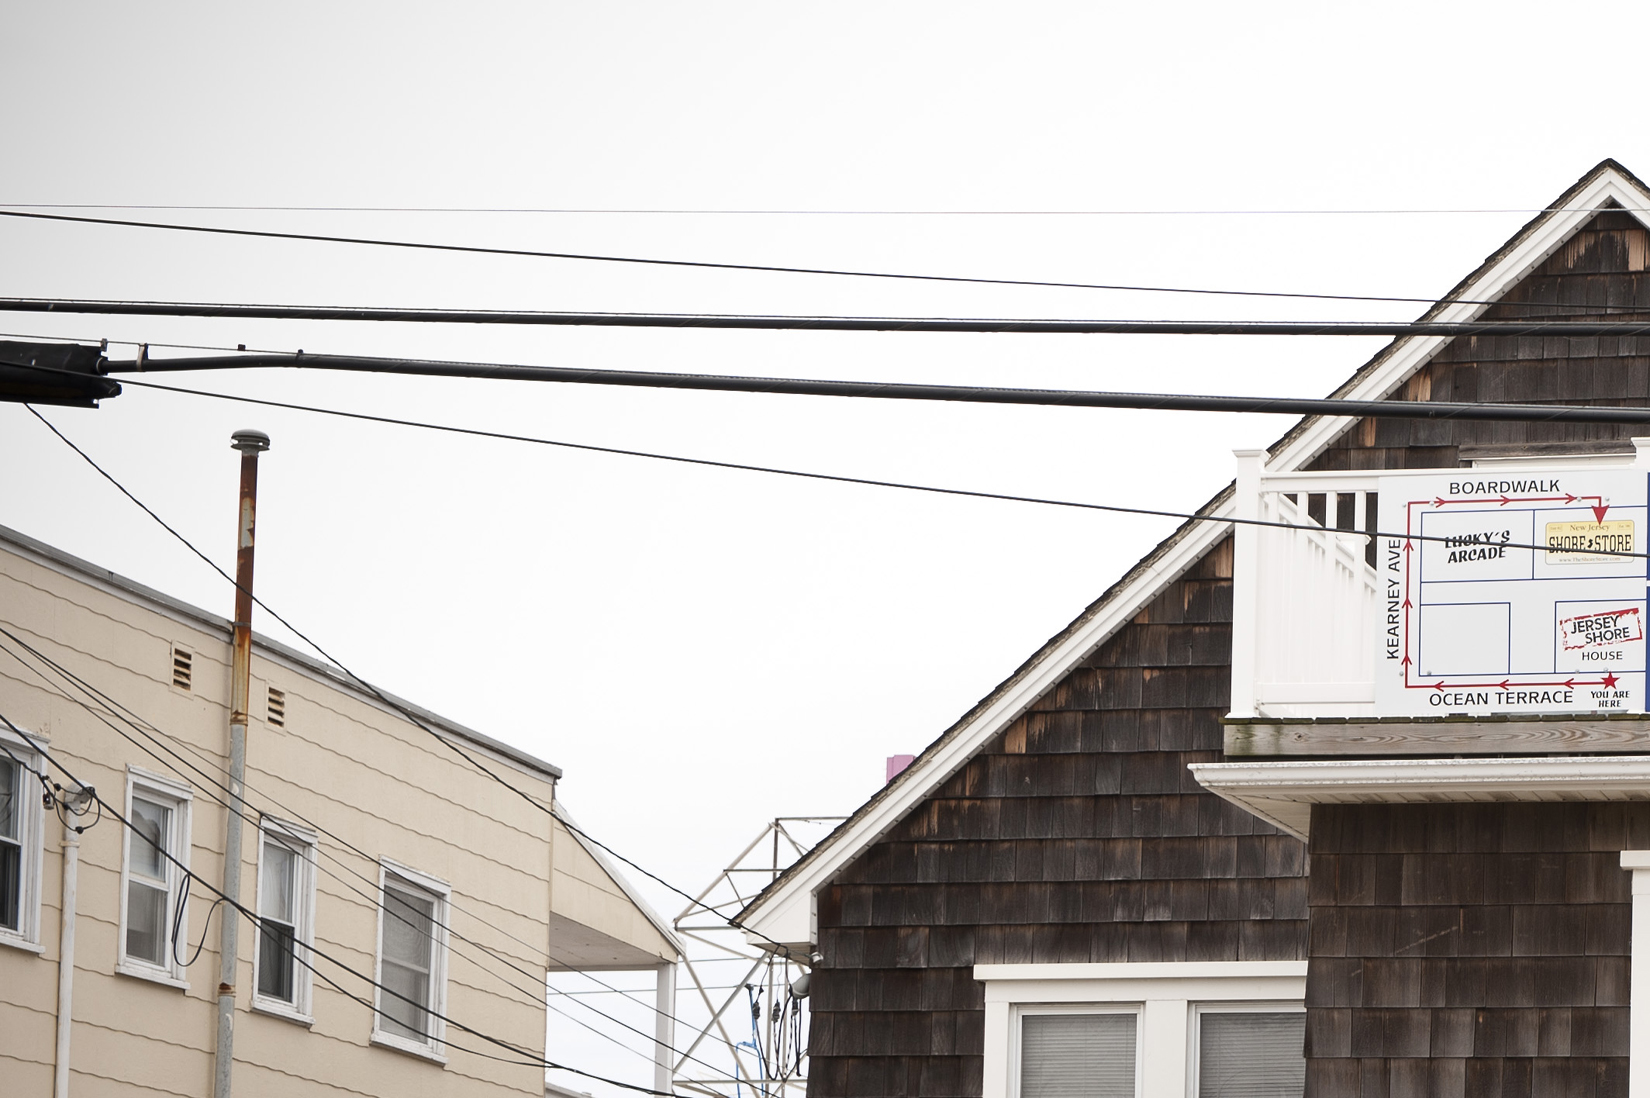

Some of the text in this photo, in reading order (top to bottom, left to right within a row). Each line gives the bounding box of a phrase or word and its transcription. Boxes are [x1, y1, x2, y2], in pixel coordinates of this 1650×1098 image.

[1449, 479, 1560, 494] BOARDWALK
[1569, 524, 1586, 532] New
[1548, 534, 1632, 553] SHORE STORE
[1447, 546, 1507, 564] ARCADE
[1386, 539, 1401, 660] KEARNEY AVE
[1571, 615, 1619, 634] JERSEY
[1585, 627, 1630, 644] SHORE
[1582, 651, 1623, 661] HOUSE
[1429, 690, 1574, 706] OCEAN TERRACE
[1590, 691, 1609, 699] YOU
[1598, 700, 1622, 708] HERE
